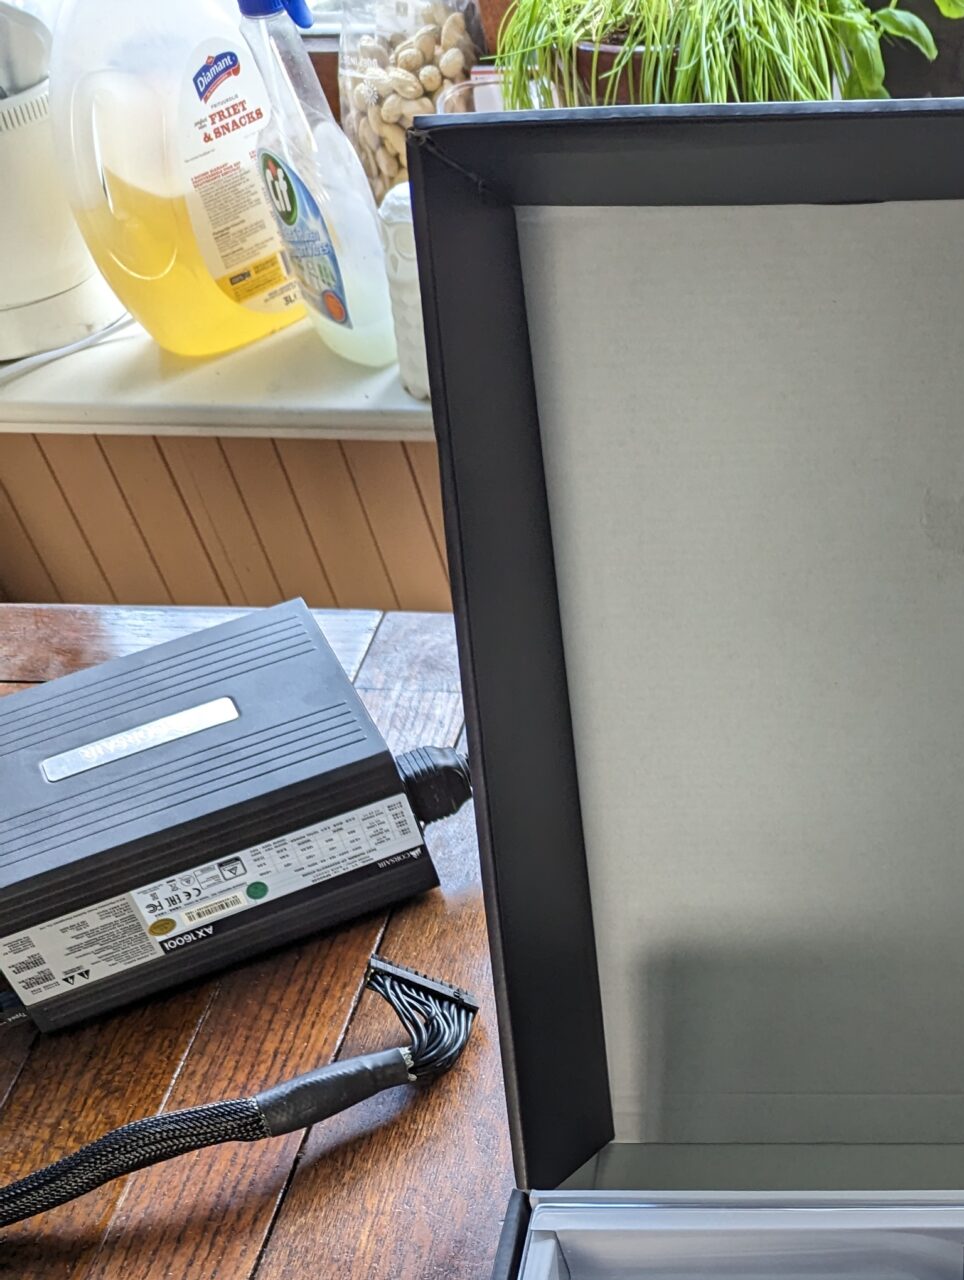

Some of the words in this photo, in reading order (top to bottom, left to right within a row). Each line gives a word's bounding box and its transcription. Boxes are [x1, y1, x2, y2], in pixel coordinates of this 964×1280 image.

[196, 54, 233, 92] Diamant
[203, 132, 214, 143] &
[213, 107, 264, 139] SNACKS
[208, 99, 248, 126] FRIET
[264, 167, 292, 212] Cif
[377, 853, 411, 869] CORSAIR
